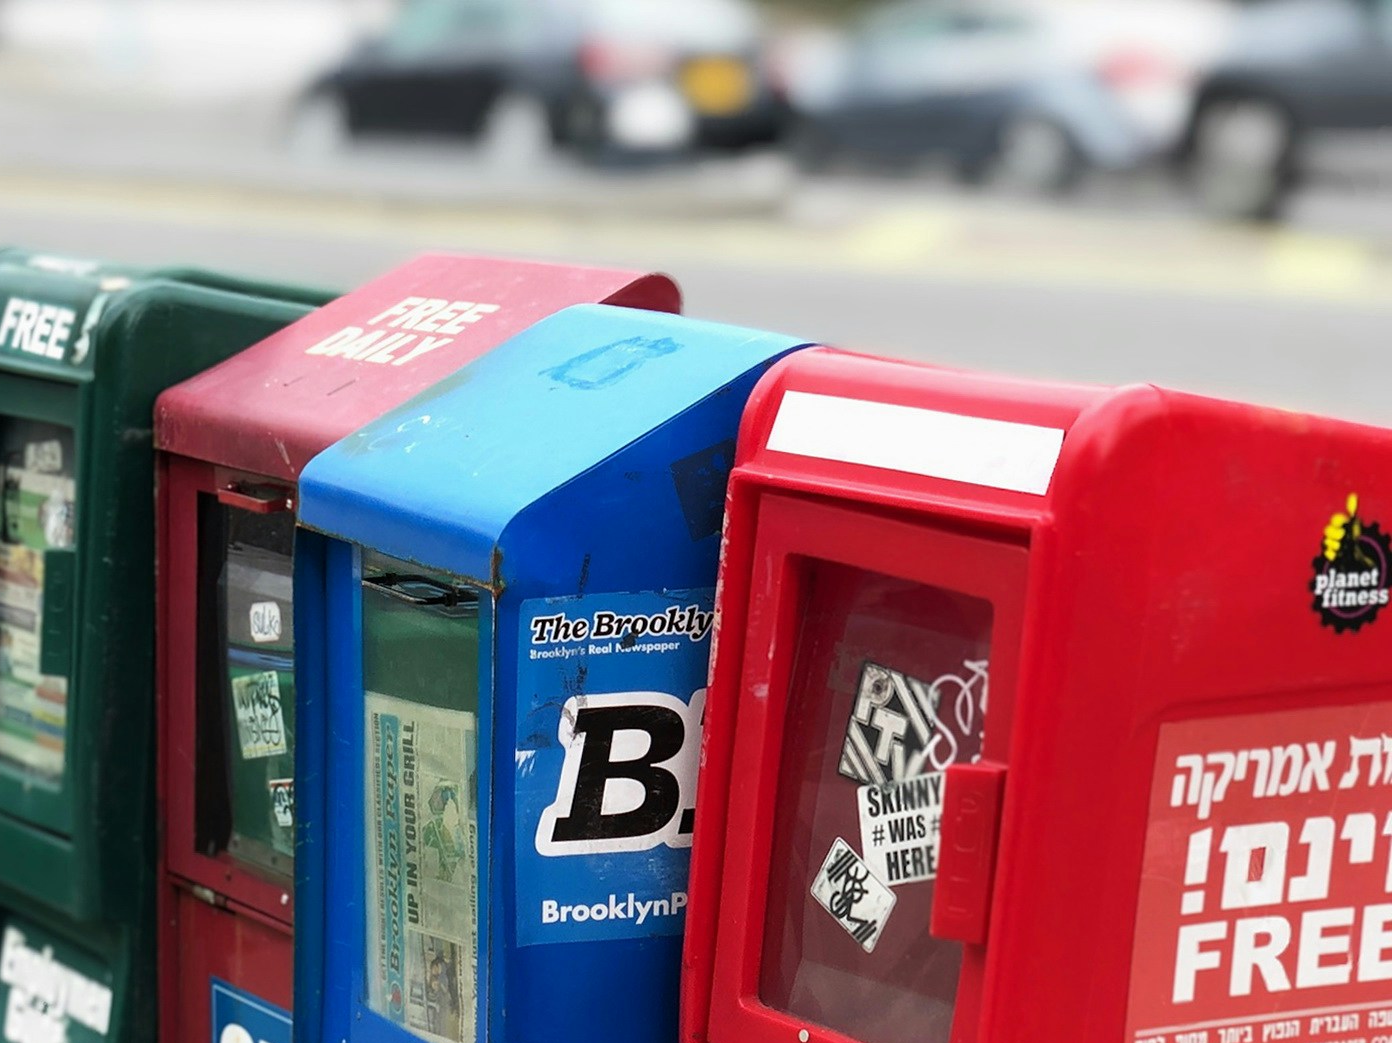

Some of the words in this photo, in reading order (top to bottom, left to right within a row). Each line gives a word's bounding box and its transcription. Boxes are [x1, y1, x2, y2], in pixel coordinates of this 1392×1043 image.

[366, 296, 501, 335] FREE
[304, 326, 454, 366] DAILY
[1314, 568, 1379, 595] planet
[1322, 588, 1389, 608] fitness
[531, 613, 588, 643] The
[529, 644, 586, 660] Brooklyn's
[588, 642, 612, 656] Real
[385, 724, 397, 821] Paper
[402, 720, 416, 788] GRILL
[546, 698, 702, 848] B
[868, 776, 942, 818] SKINNY
[1170, 740, 1336, 820] אמריקה
[404, 792, 417, 856] YOUR
[887, 815, 927, 844] WAS
[468, 823, 476, 870] along
[885, 845, 936, 882] HERE
[1181, 812, 1392, 915] ינם!
[406, 861, 418, 888] IN
[387, 832, 400, 975] Brooklyn
[407, 893, 420, 925] UP
